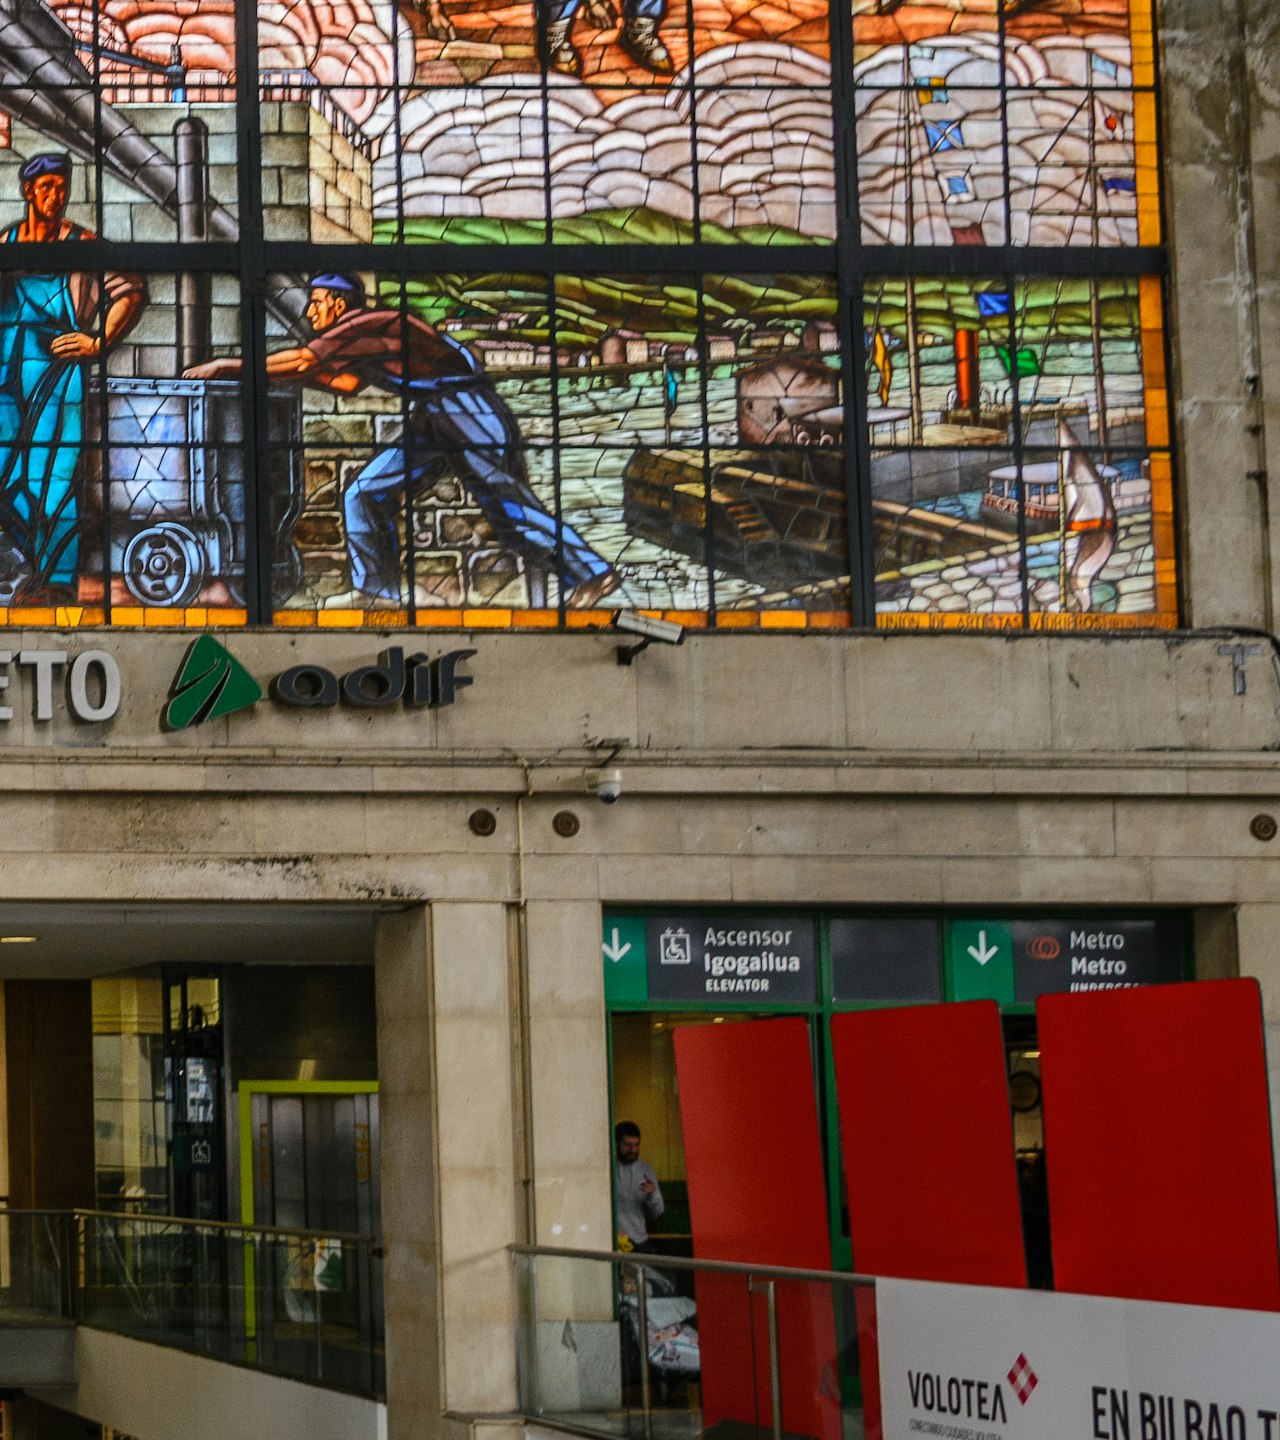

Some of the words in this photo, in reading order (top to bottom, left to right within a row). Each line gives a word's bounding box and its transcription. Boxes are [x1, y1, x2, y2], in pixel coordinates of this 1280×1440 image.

[271, 646, 478, 708] adif
[704, 927, 792, 946] Ascensor
[1070, 930, 1124, 950] Metro
[704, 951, 800, 976] Igogailua
[1071, 956, 1127, 975] Metro
[705, 979, 770, 992] ELEVATOR
[907, 1370, 1008, 1424] VOLOTEA
[1092, 1385, 1131, 1440] EN
